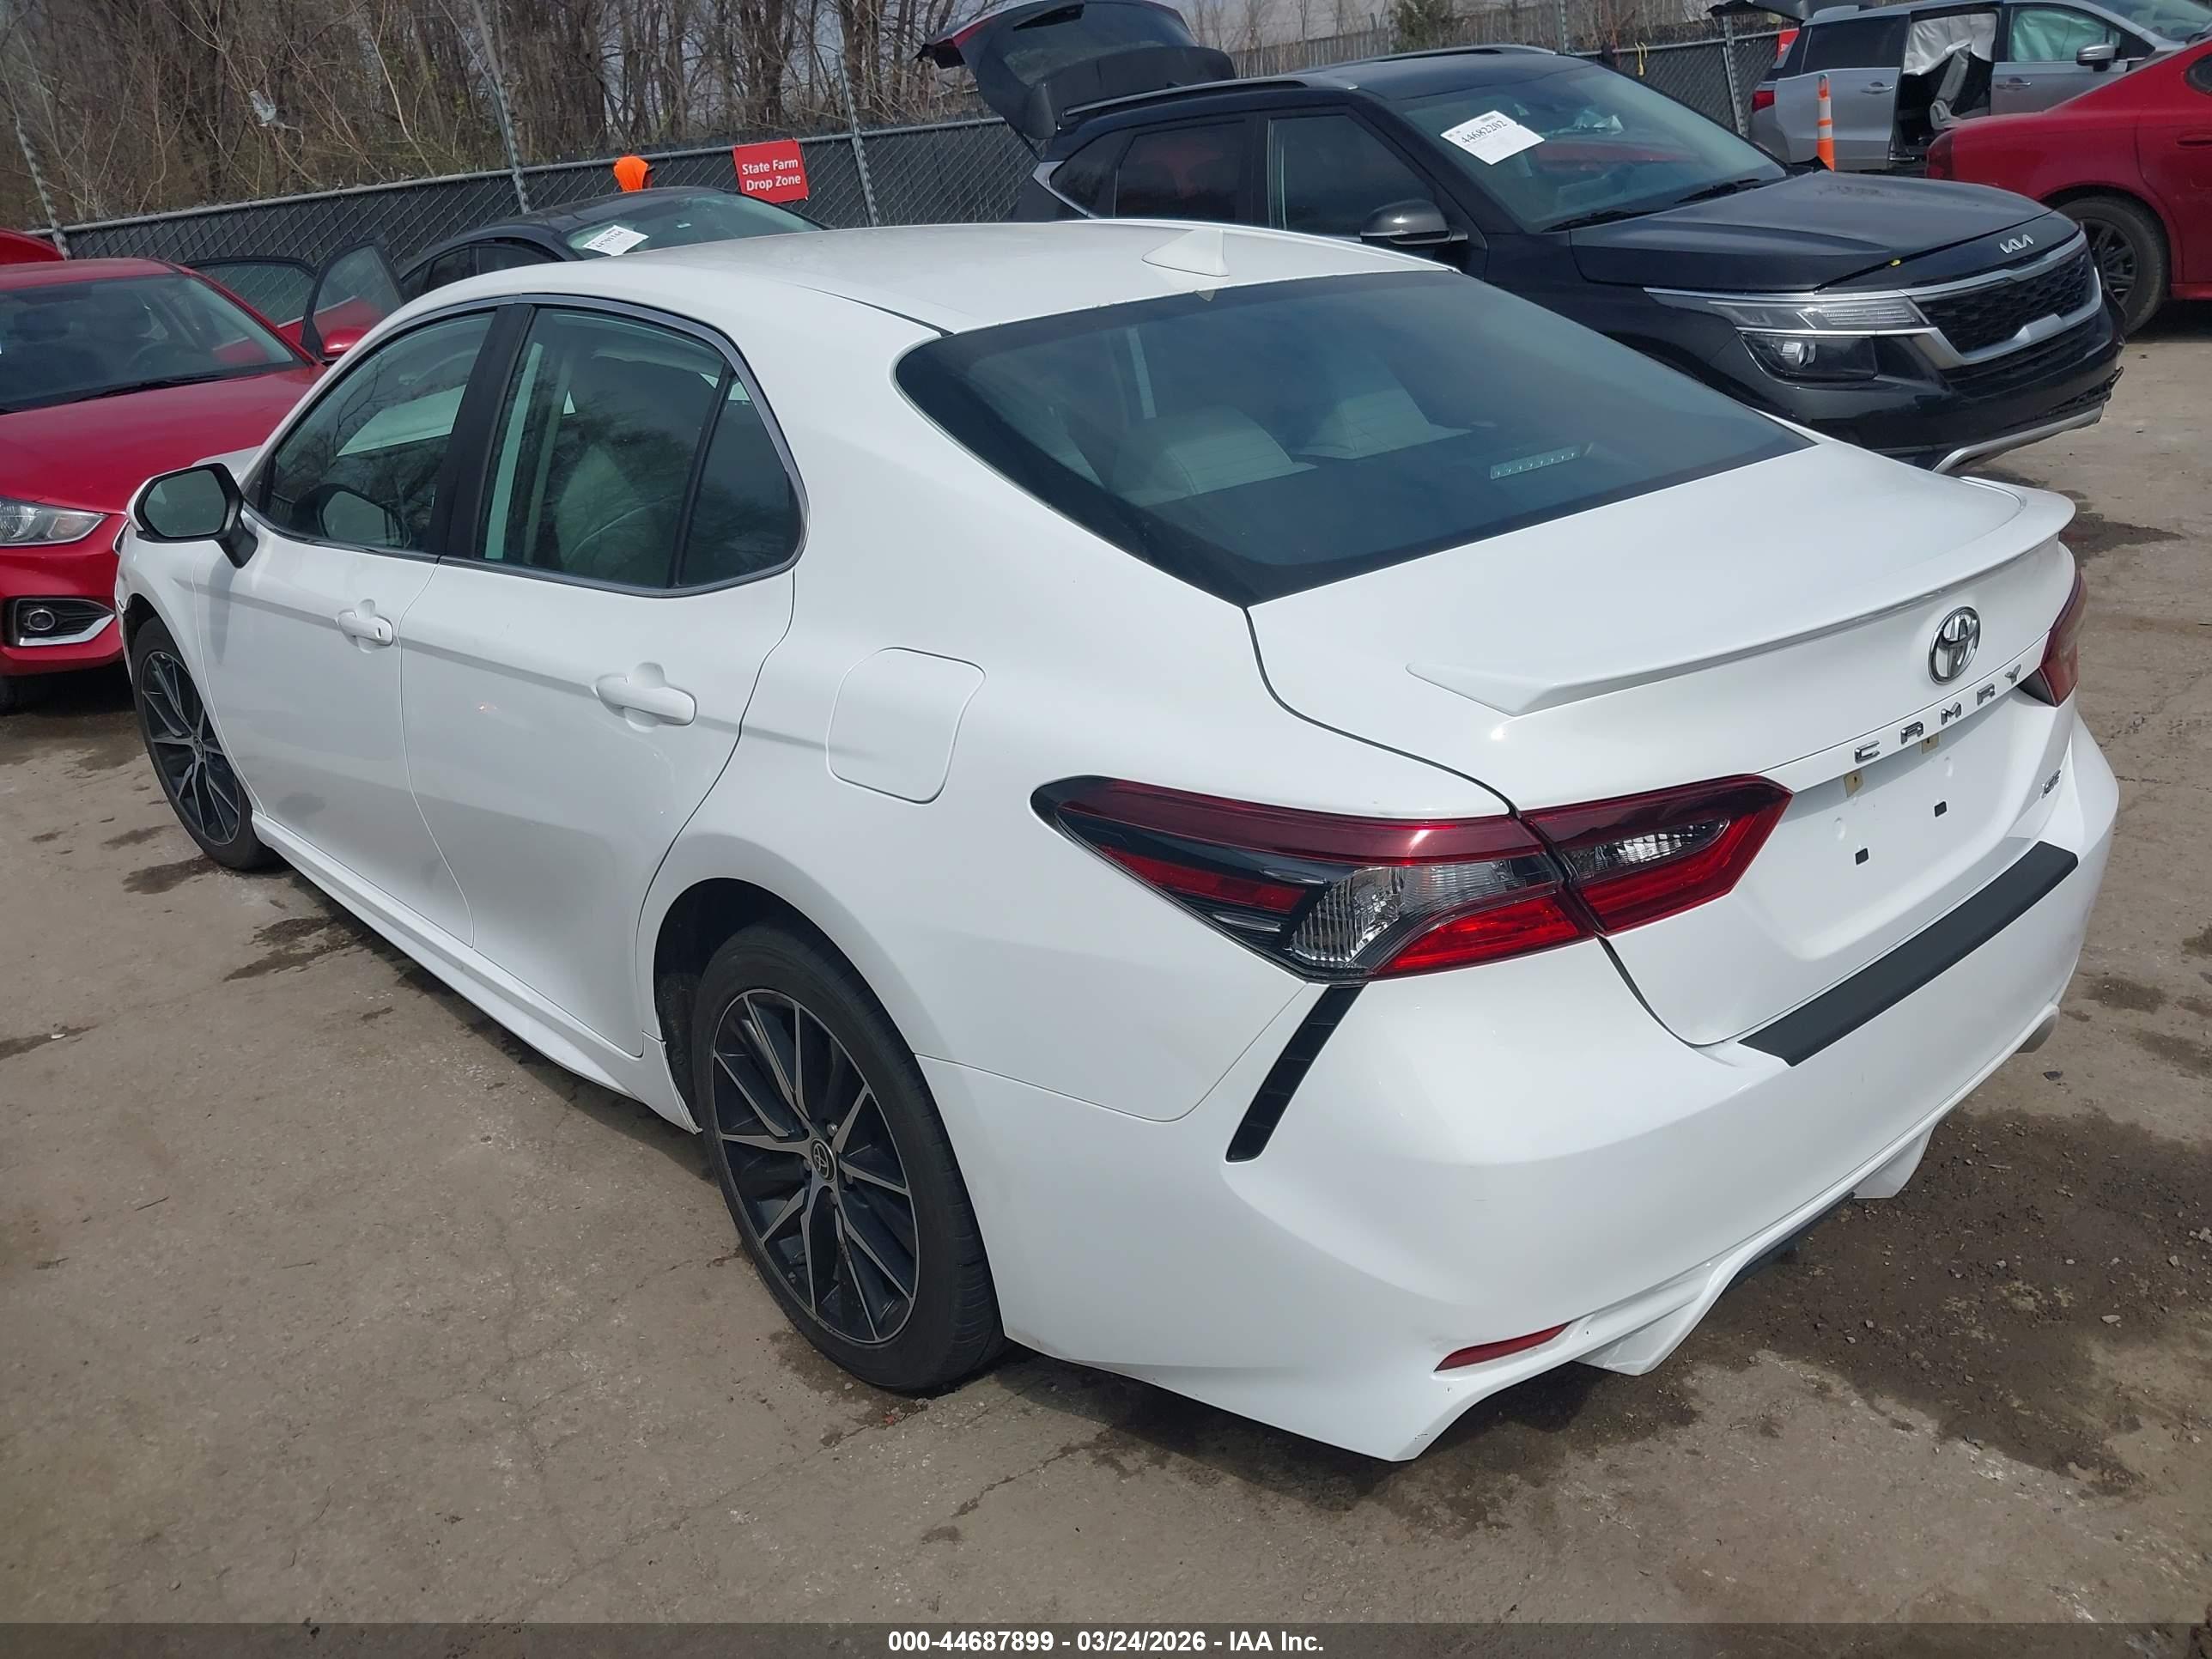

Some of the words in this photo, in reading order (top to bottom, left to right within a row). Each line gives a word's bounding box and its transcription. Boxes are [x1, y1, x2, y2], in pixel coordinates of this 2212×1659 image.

[742, 162, 770, 175] State
[773, 159, 799, 171] Farm
[746, 179, 773, 191] Drop
[776, 175, 801, 187] Zone
[1854, 663, 2022, 764] CAMRY
